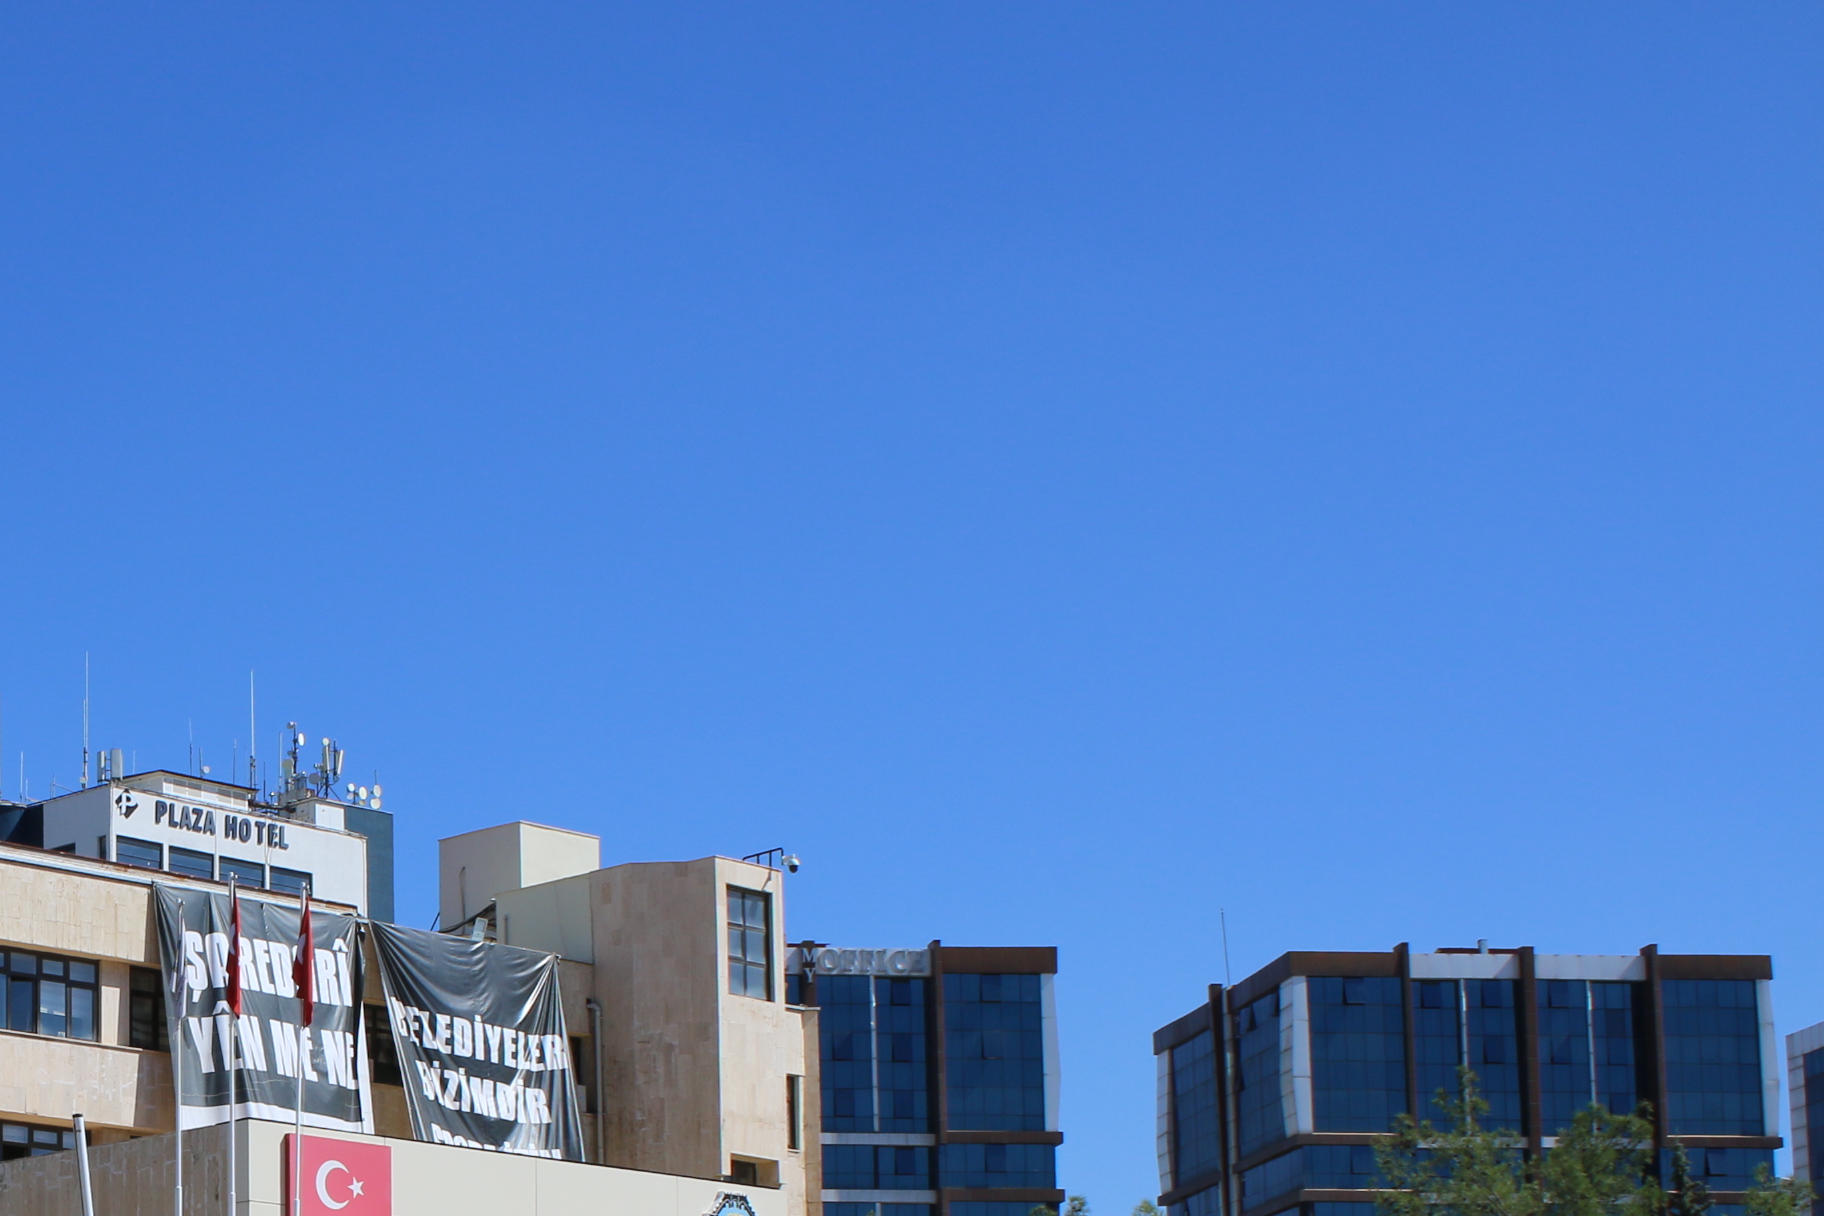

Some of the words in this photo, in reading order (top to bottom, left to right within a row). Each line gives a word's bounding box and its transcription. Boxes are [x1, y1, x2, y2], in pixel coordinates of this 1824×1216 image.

[154, 800, 217, 835] PLAZA
[224, 814, 290, 850] HOTEL
[185, 930, 353, 1008] ŞAREDRÎ
[818, 949, 925, 973] OFFICE
[320, 1029, 360, 1091] NE
[415, 1059, 553, 1125] BİZİMDİR
